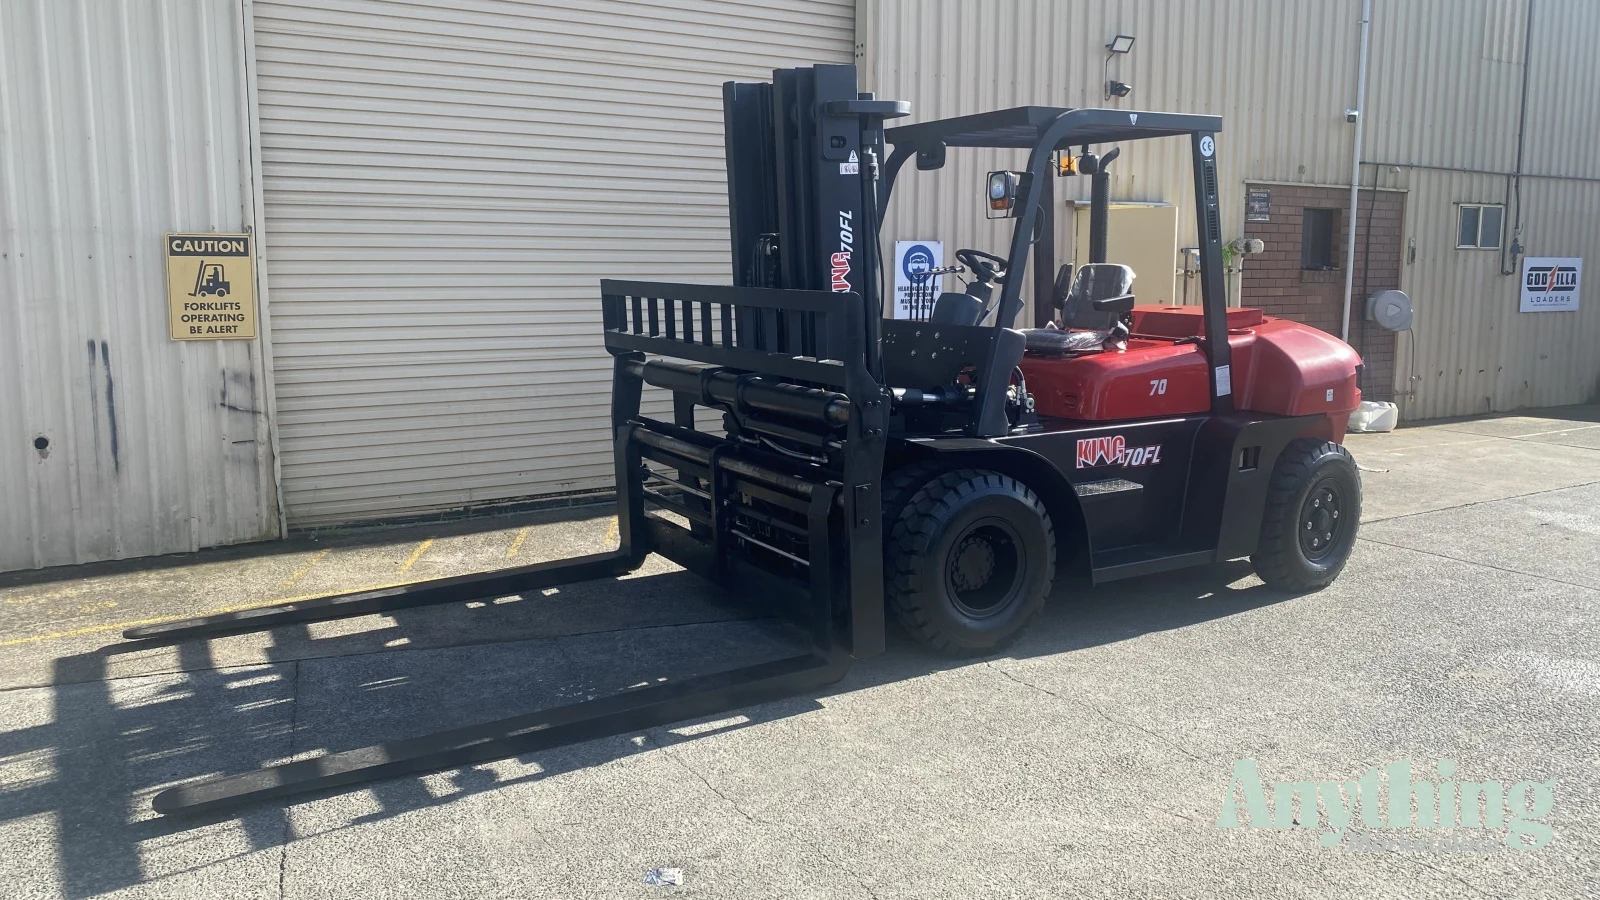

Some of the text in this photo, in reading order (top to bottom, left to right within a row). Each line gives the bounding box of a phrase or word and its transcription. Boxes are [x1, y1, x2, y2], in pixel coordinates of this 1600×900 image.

[839, 210, 853, 252] 70FL
[172, 240, 244, 252] CAUTION
[184, 302, 241, 311] FORKLIFTS
[181, 313, 245, 323] OPERATING
[189, 325, 238, 334] BE ALERT
[1149, 379, 1167, 396] 70
[1076, 435, 1161, 469] KING 70FL
